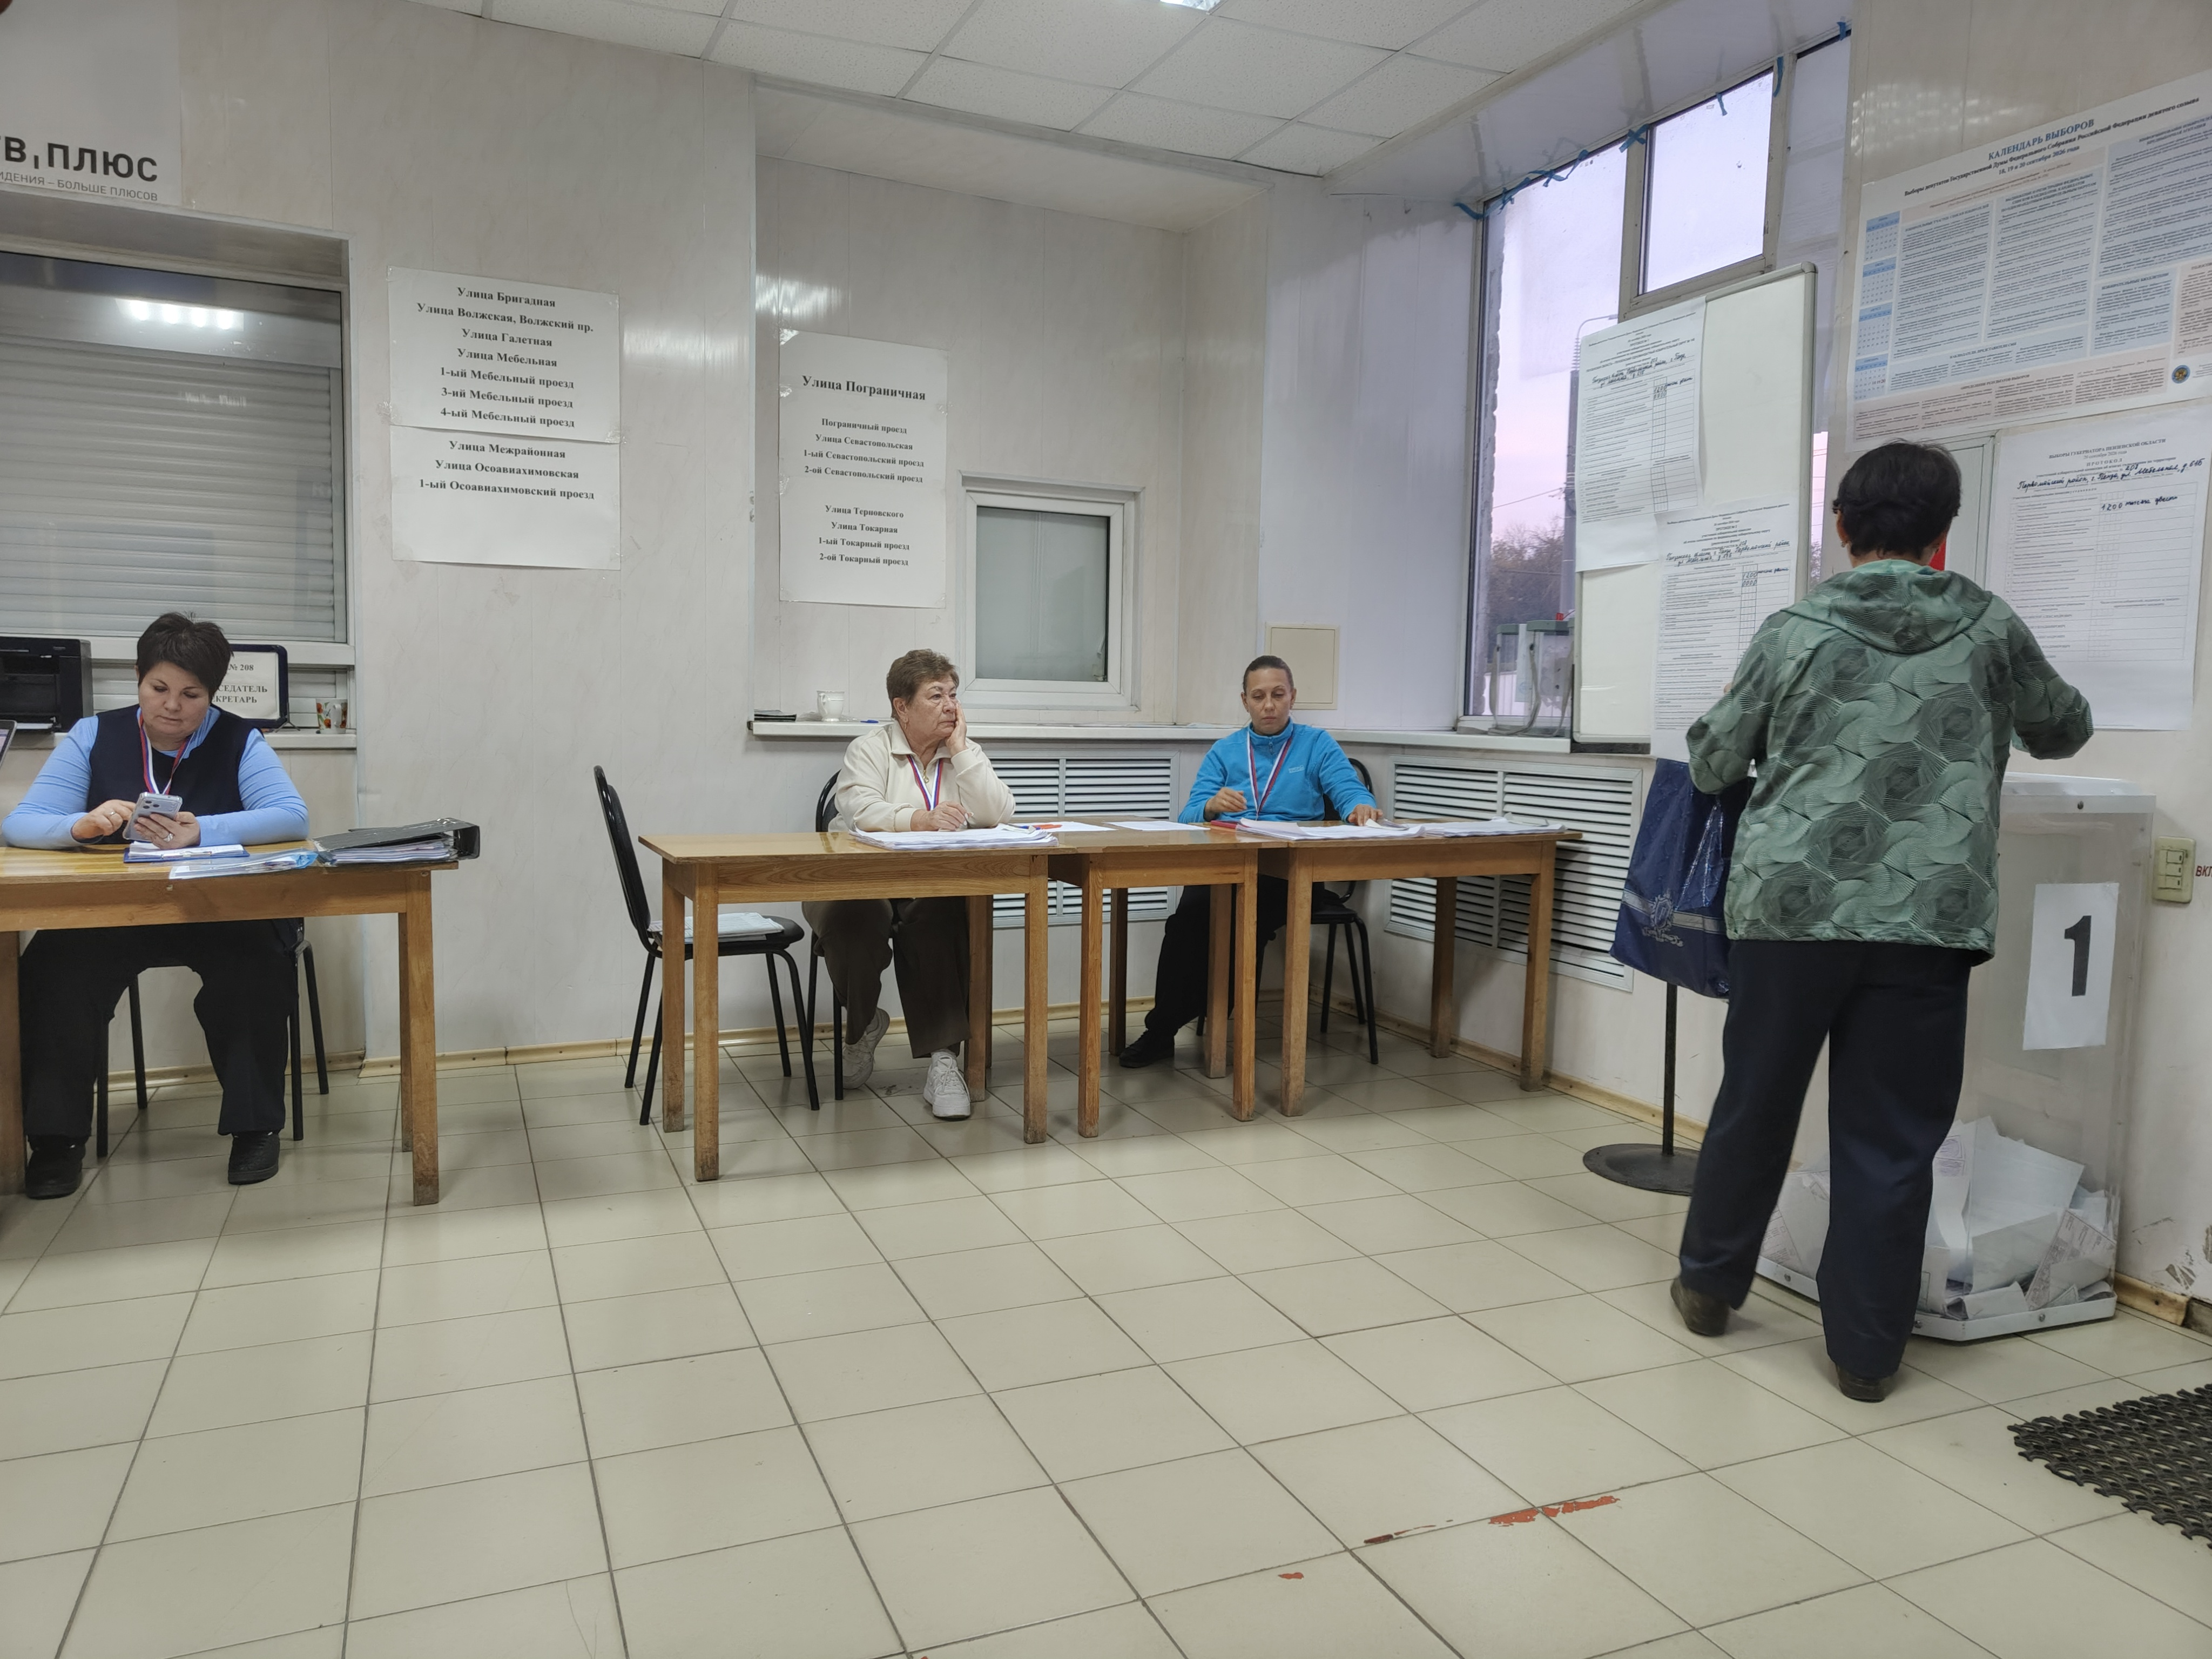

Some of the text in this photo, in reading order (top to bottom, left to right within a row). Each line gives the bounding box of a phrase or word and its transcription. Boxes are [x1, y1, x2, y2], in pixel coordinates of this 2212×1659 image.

[1988, 119, 2095, 160] КАЛЕНДАРЬ ВЫБОРОВ
[57, 179, 107, 194] БОЛЬШЕ
[110, 187, 158, 201] ПЛЮСОВ
[457, 287, 555, 307] Улица Бригадная
[416, 302, 594, 334] Улица Волжская, Волжский пр.
[461, 328, 552, 347] Улица Галетная
[457, 348, 557, 367] Улица Мебельная
[440, 367, 574, 389] 1-ый Мебельный проезд
[802, 375, 926, 401] Улица Пограничная
[441, 387, 574, 409] 3-ий Мебельный проезд
[440, 407, 575, 428] 4-ый Мебельный проезд
[821, 418, 907, 434] Пограничный проезд
[449, 440, 565, 458] Улица Межрайонная
[815, 434, 913, 450] Улица Севастопольская
[2071, 448, 2105, 456] ГУБЕРНАТОРА
[2141, 439, 2166, 447] ОБЛАСТИ
[804, 449, 824, 458] 1-ый
[825, 451, 896, 464] Севастопольский
[435, 460, 579, 479] Улица Осоавиахимовская
[804, 466, 923, 483] 2-ой Севастопольский проезд
[419, 478, 595, 500] 1-ый Осоавиахимовский проезд
[825, 504, 904, 518] Улица Терновского
[831, 521, 898, 534] Улица Токарная
[818, 537, 910, 551] 1-ый Токарный проезд
[819, 552, 908, 567] 2-ой Токарный проезд
[2064, 915, 2092, 996] 1
